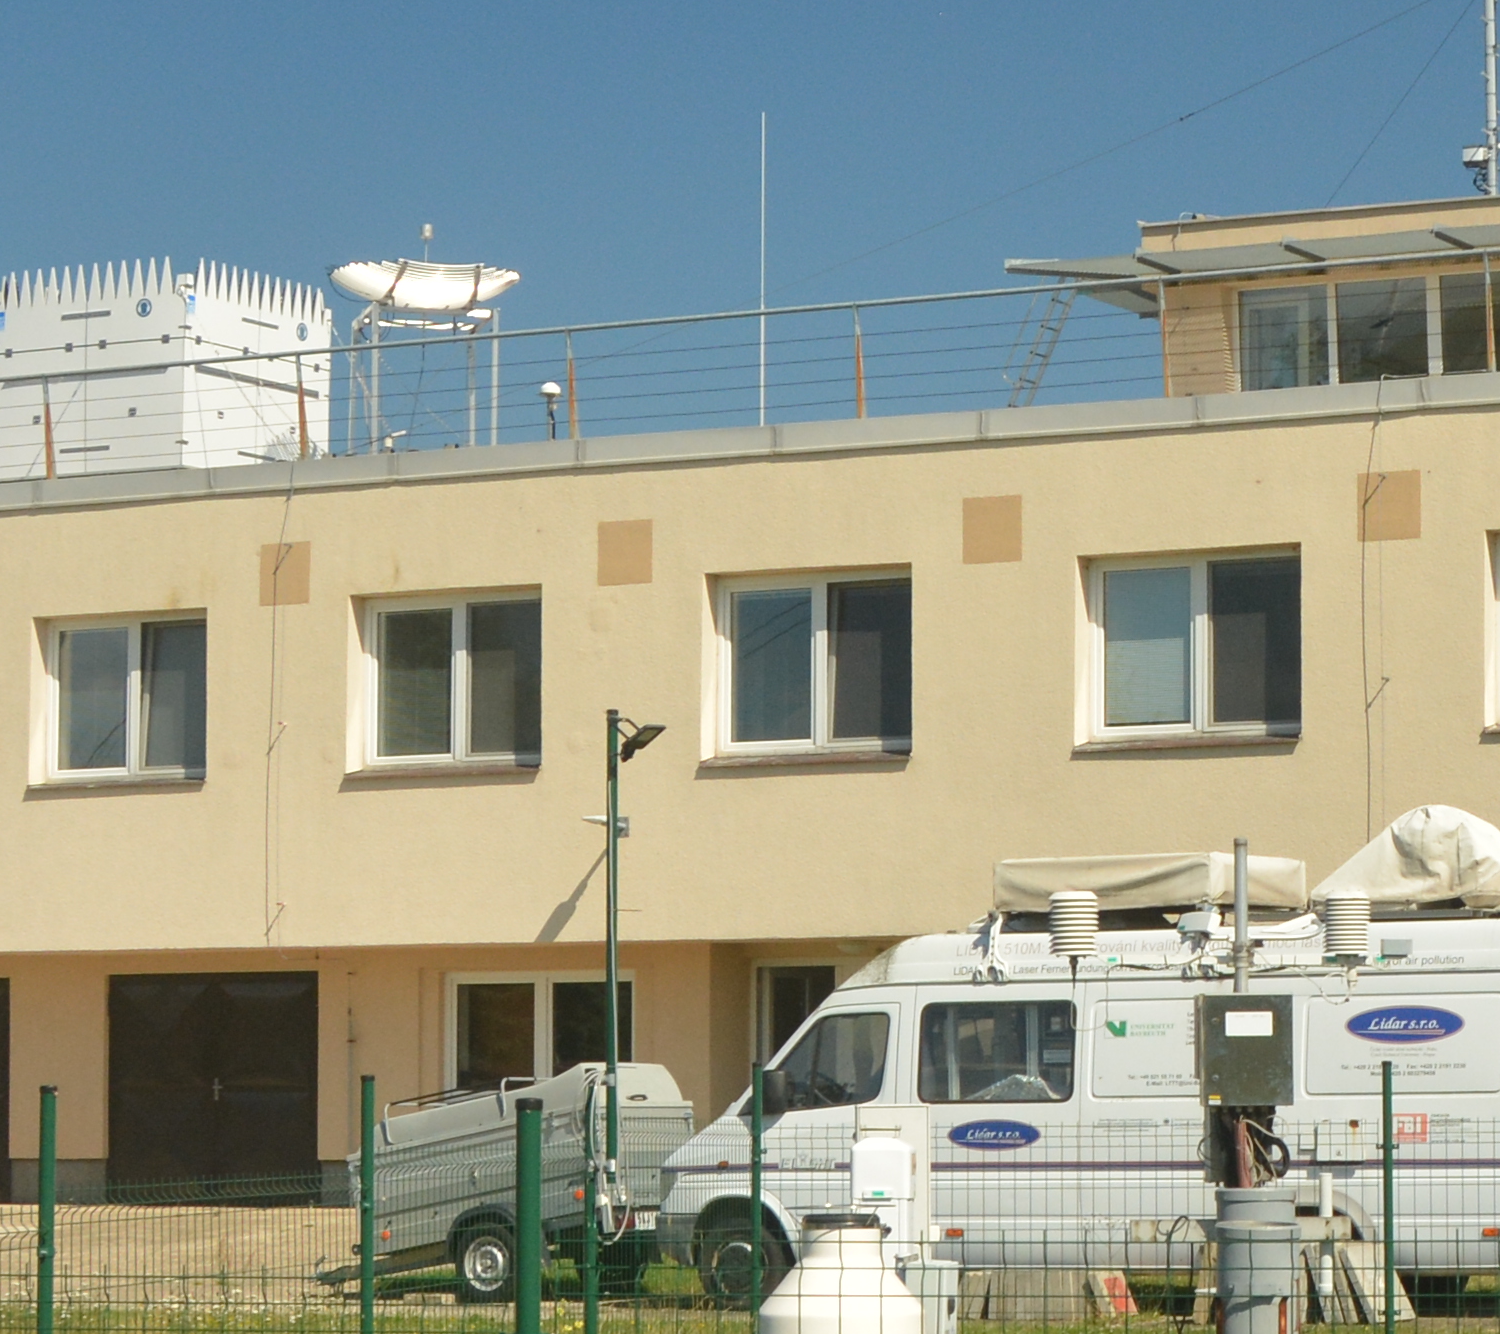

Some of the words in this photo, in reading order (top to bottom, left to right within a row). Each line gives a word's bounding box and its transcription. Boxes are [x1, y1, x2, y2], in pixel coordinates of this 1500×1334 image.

[1004, 942, 1045, 956] 510M:
[1141, 938, 1182, 954] kvality
[1405, 956, 1418, 965] air
[1421, 955, 1464, 966] pollution
[1013, 965, 1039, 975] Laser
[1367, 1016, 1407, 1030] Lidar
[1408, 1019, 1440, 1030] s.r.o.
[965, 1128, 997, 1140] Lidar
